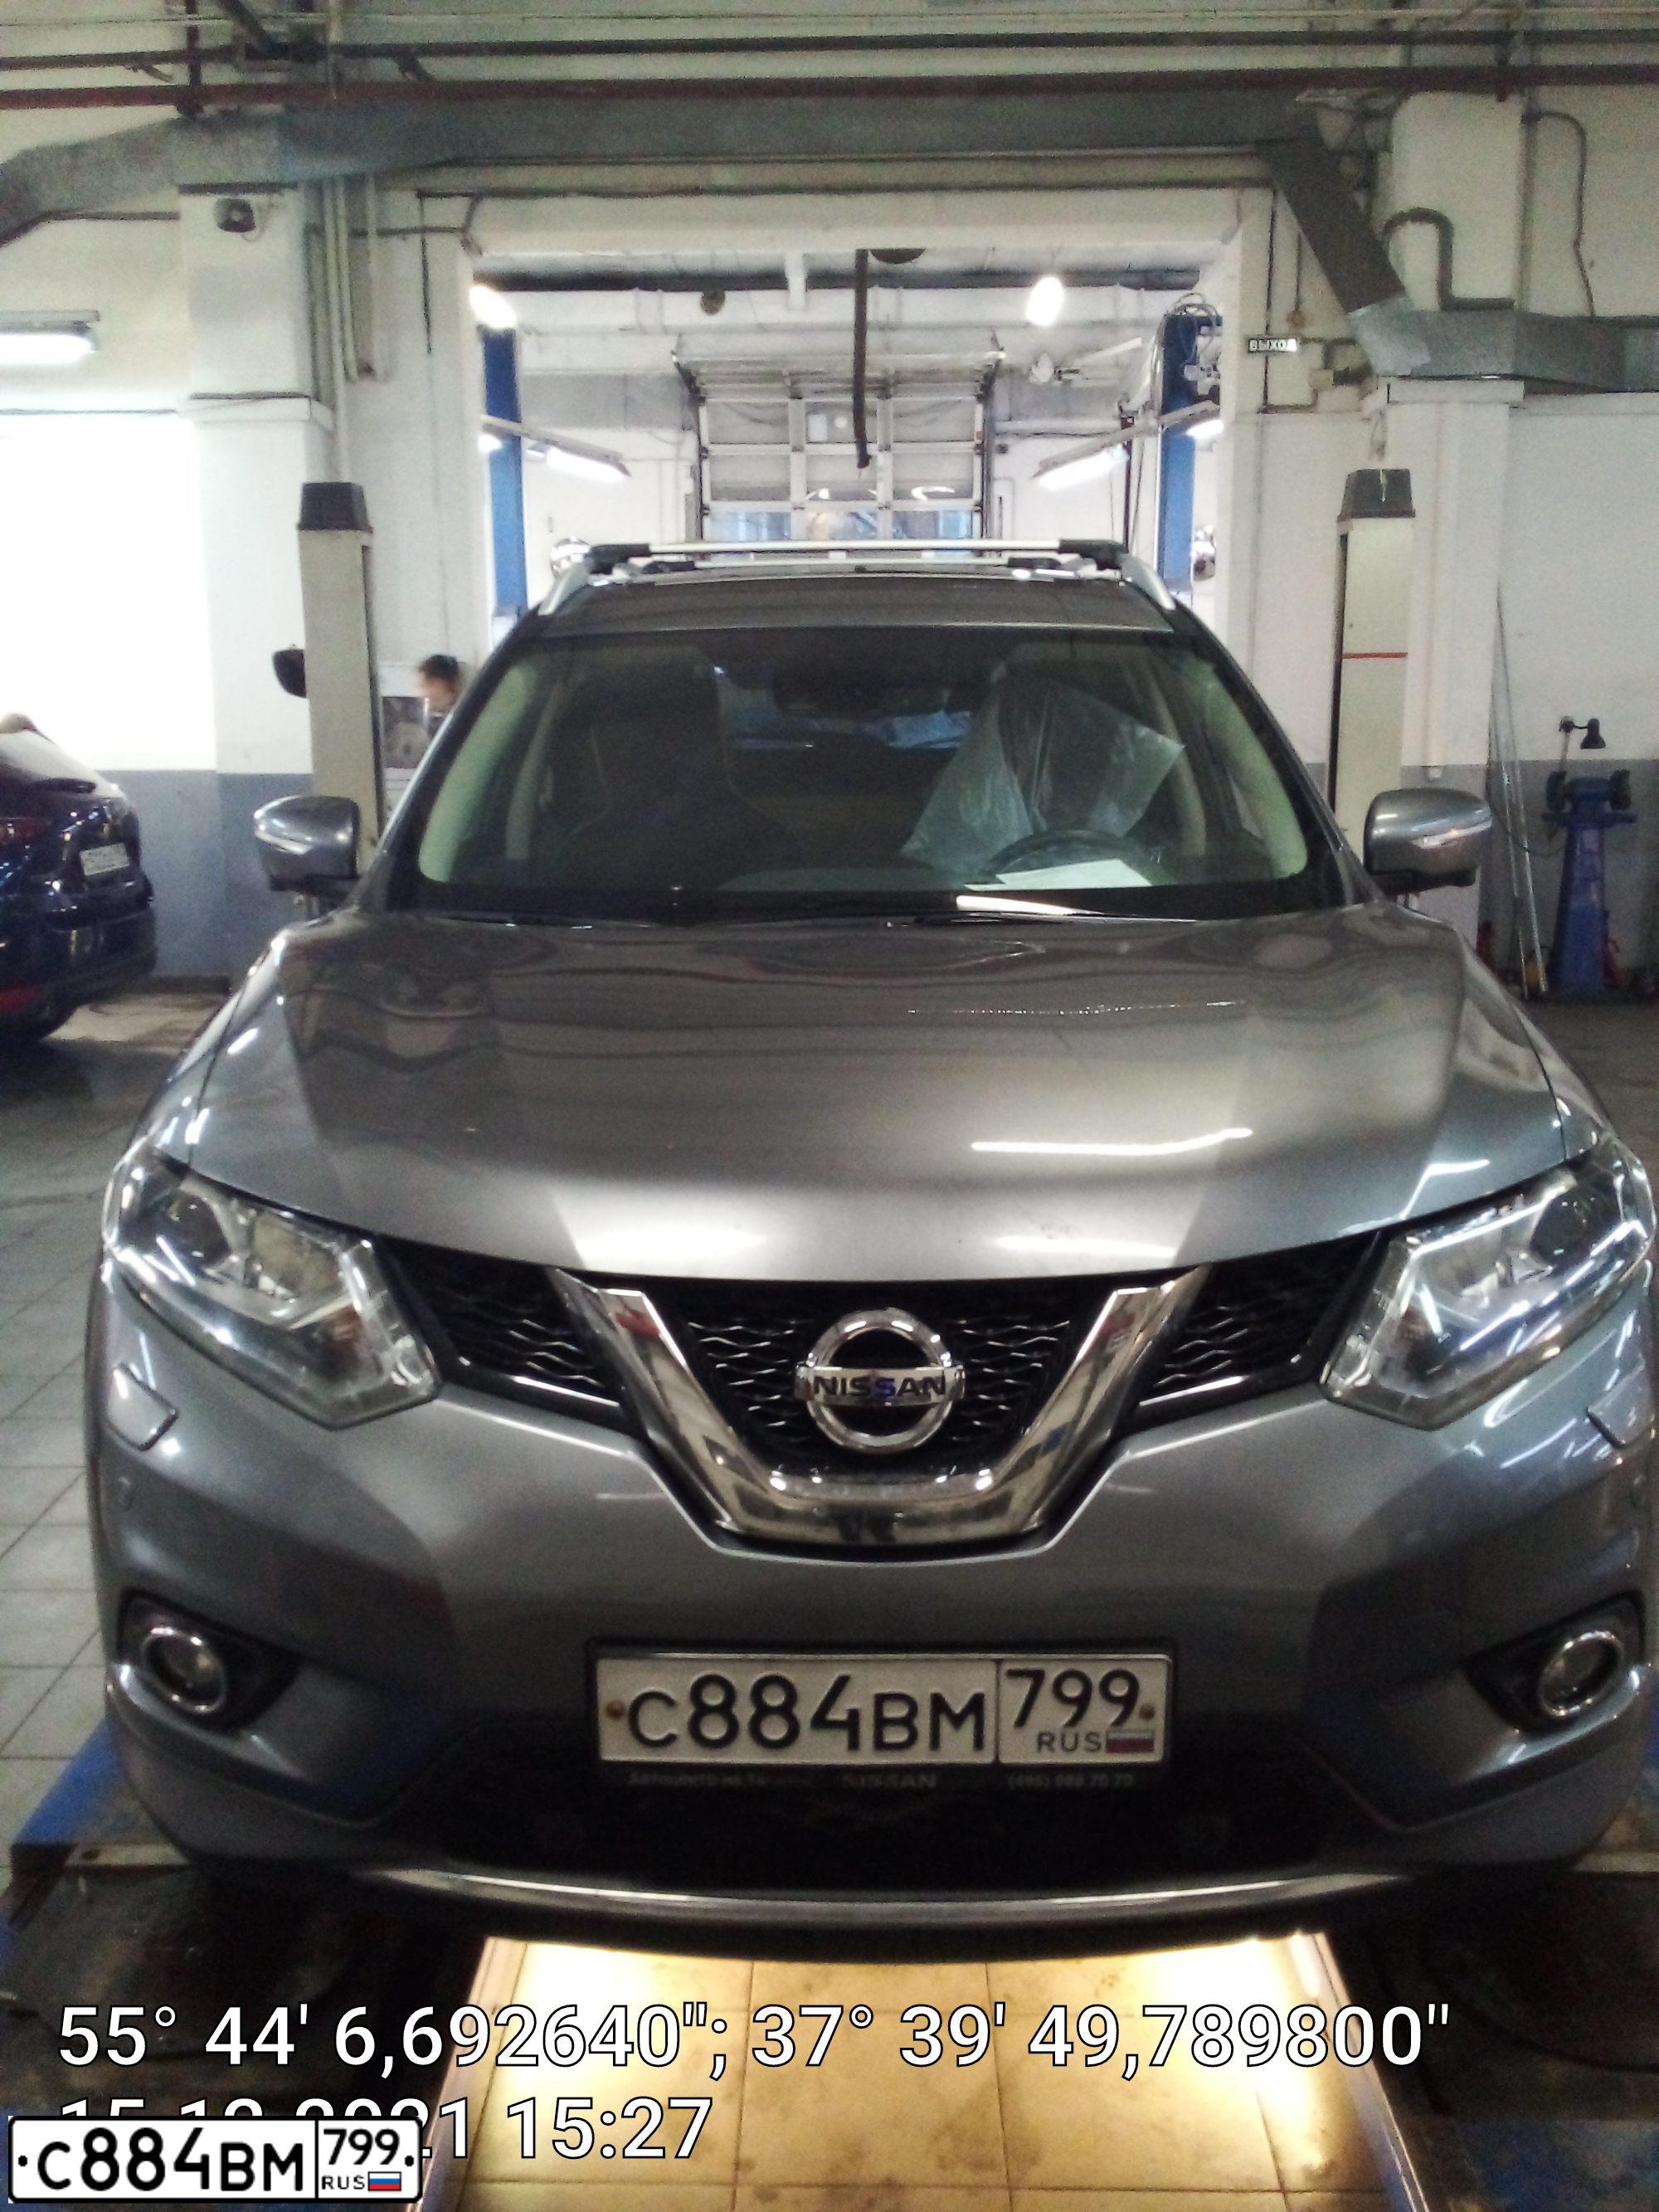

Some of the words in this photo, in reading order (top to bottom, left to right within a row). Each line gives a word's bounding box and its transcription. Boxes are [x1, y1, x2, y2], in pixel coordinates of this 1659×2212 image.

[813, 1375, 946, 1398] NISSAN
[1005, 1669, 1140, 1728] 799
[1037, 1732, 1102, 1753] RUS
